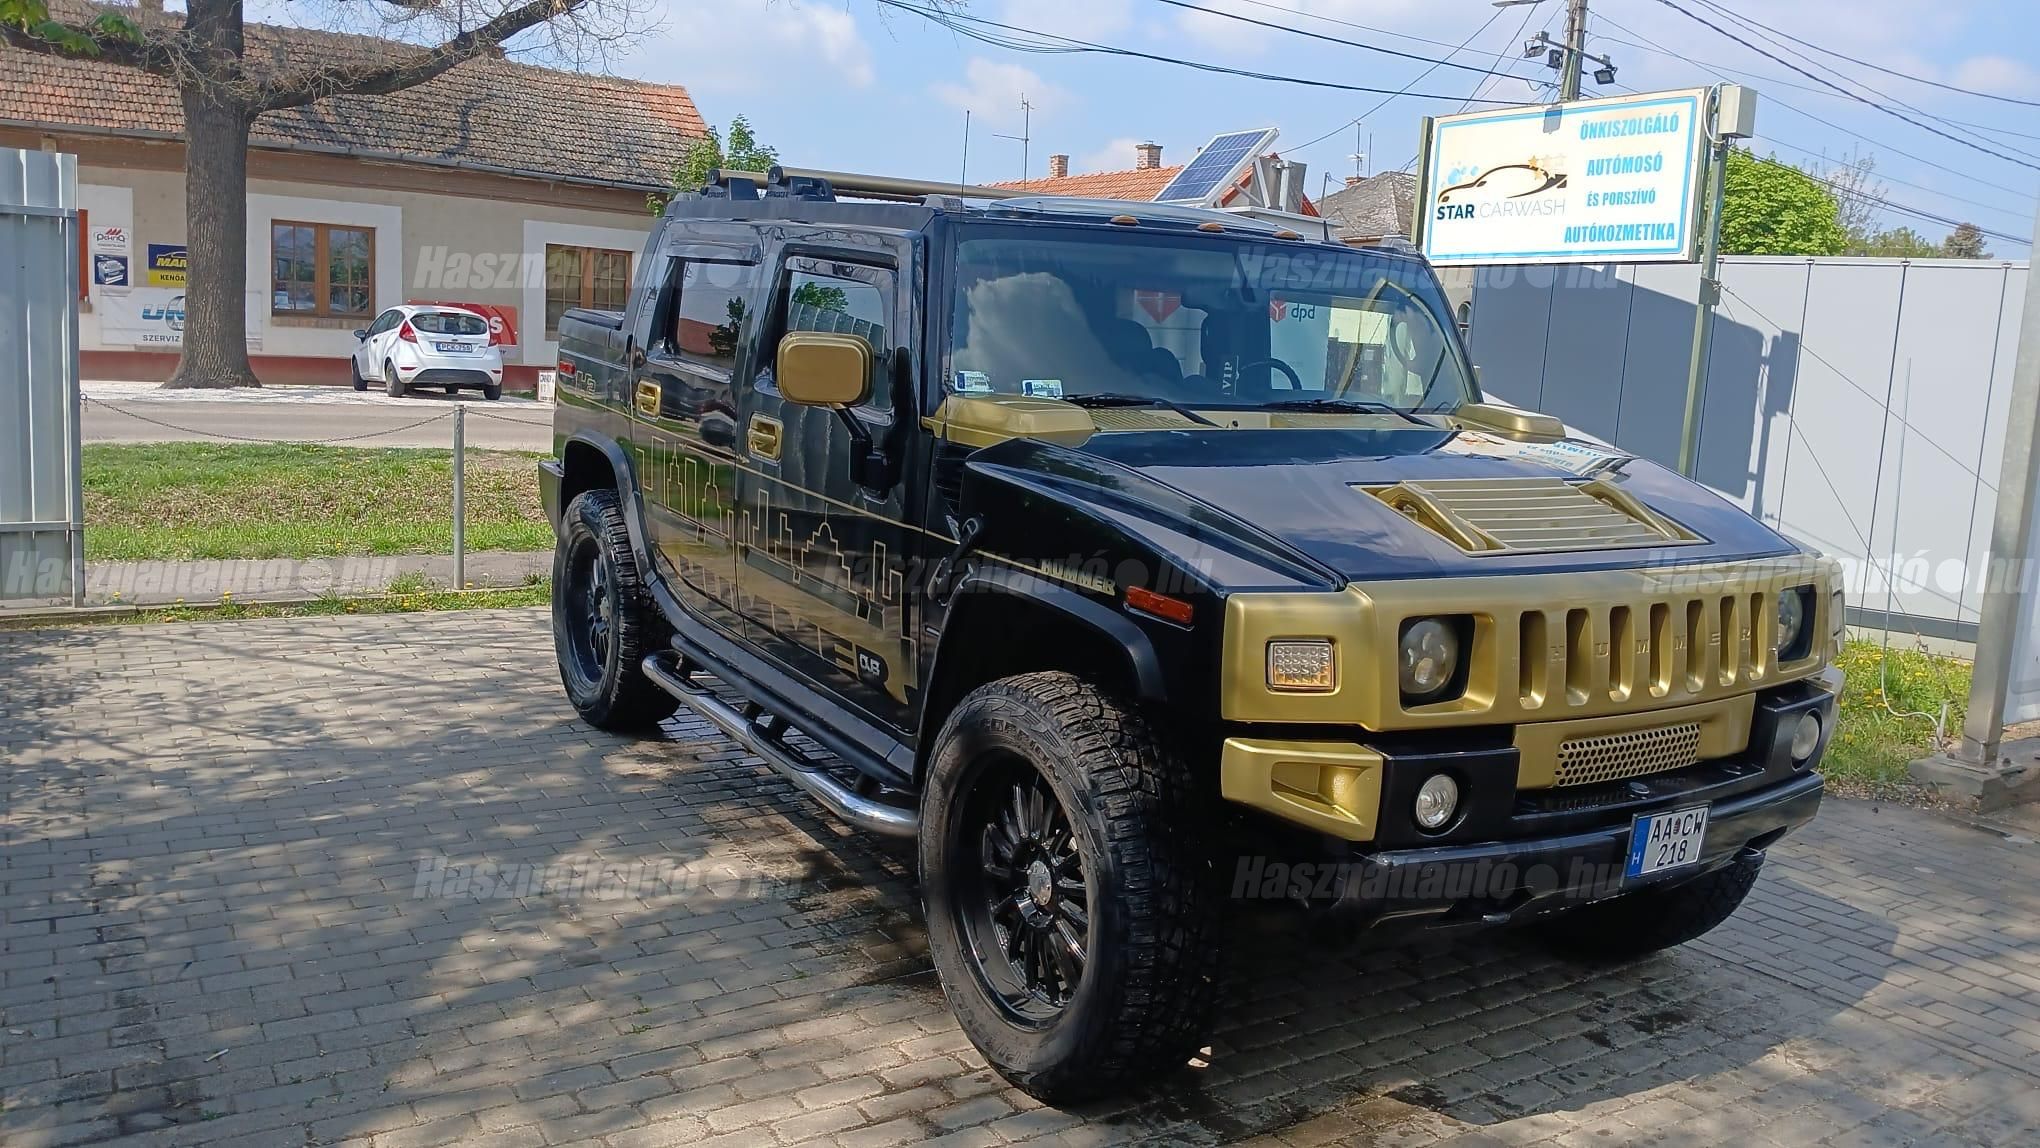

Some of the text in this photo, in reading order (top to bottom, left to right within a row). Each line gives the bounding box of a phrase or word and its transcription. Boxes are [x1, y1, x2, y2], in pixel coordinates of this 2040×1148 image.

[1580, 112, 1679, 141] ÖNKISZOLGÁLÓ
[1586, 151, 1663, 176] AUTÓMOSÓ
[1586, 187, 1656, 207] ÉS PORSZÍVÓ
[1436, 199, 1566, 220] STAR CARWASH
[1564, 222, 1675, 244] AUTÓKOZMETIKA
[1291, 303, 1316, 322] dpd
[1040, 558, 1116, 597] HUMMER
[1656, 839, 1688, 867] 218
